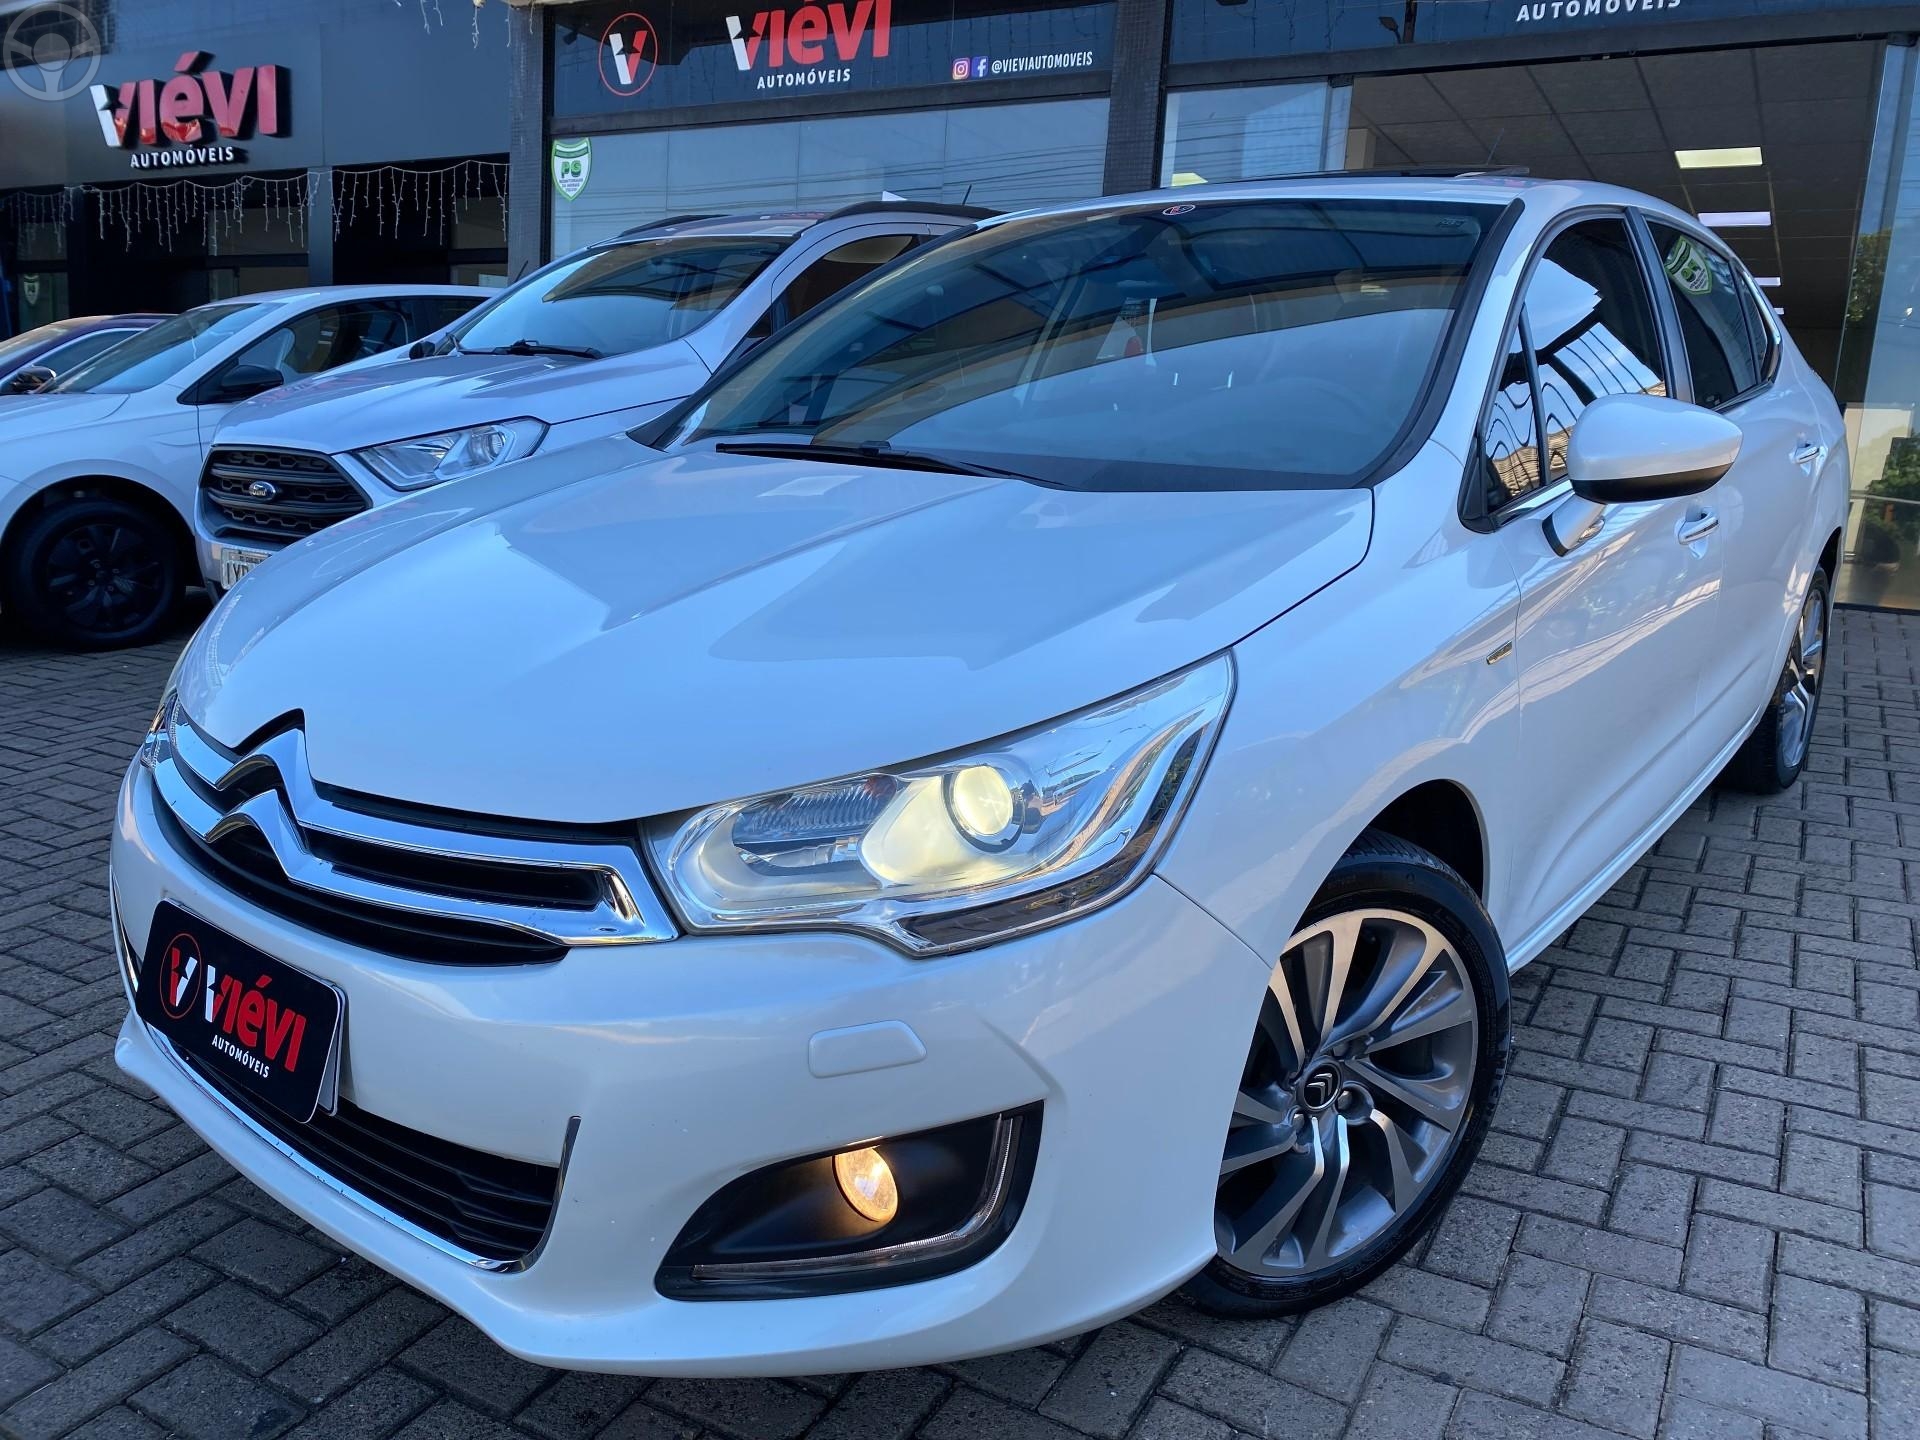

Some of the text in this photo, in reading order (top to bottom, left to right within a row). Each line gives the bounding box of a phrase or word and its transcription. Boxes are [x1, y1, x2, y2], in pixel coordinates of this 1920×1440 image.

[991, 51, 1093, 74] @VIEVIAUTOMOVEIS
[757, 68, 851, 89] AUTOMÓVEIS
[130, 145, 235, 168] AUTOMÓVEIS
[211, 1034, 270, 1078] AUTOMÓVEIS
